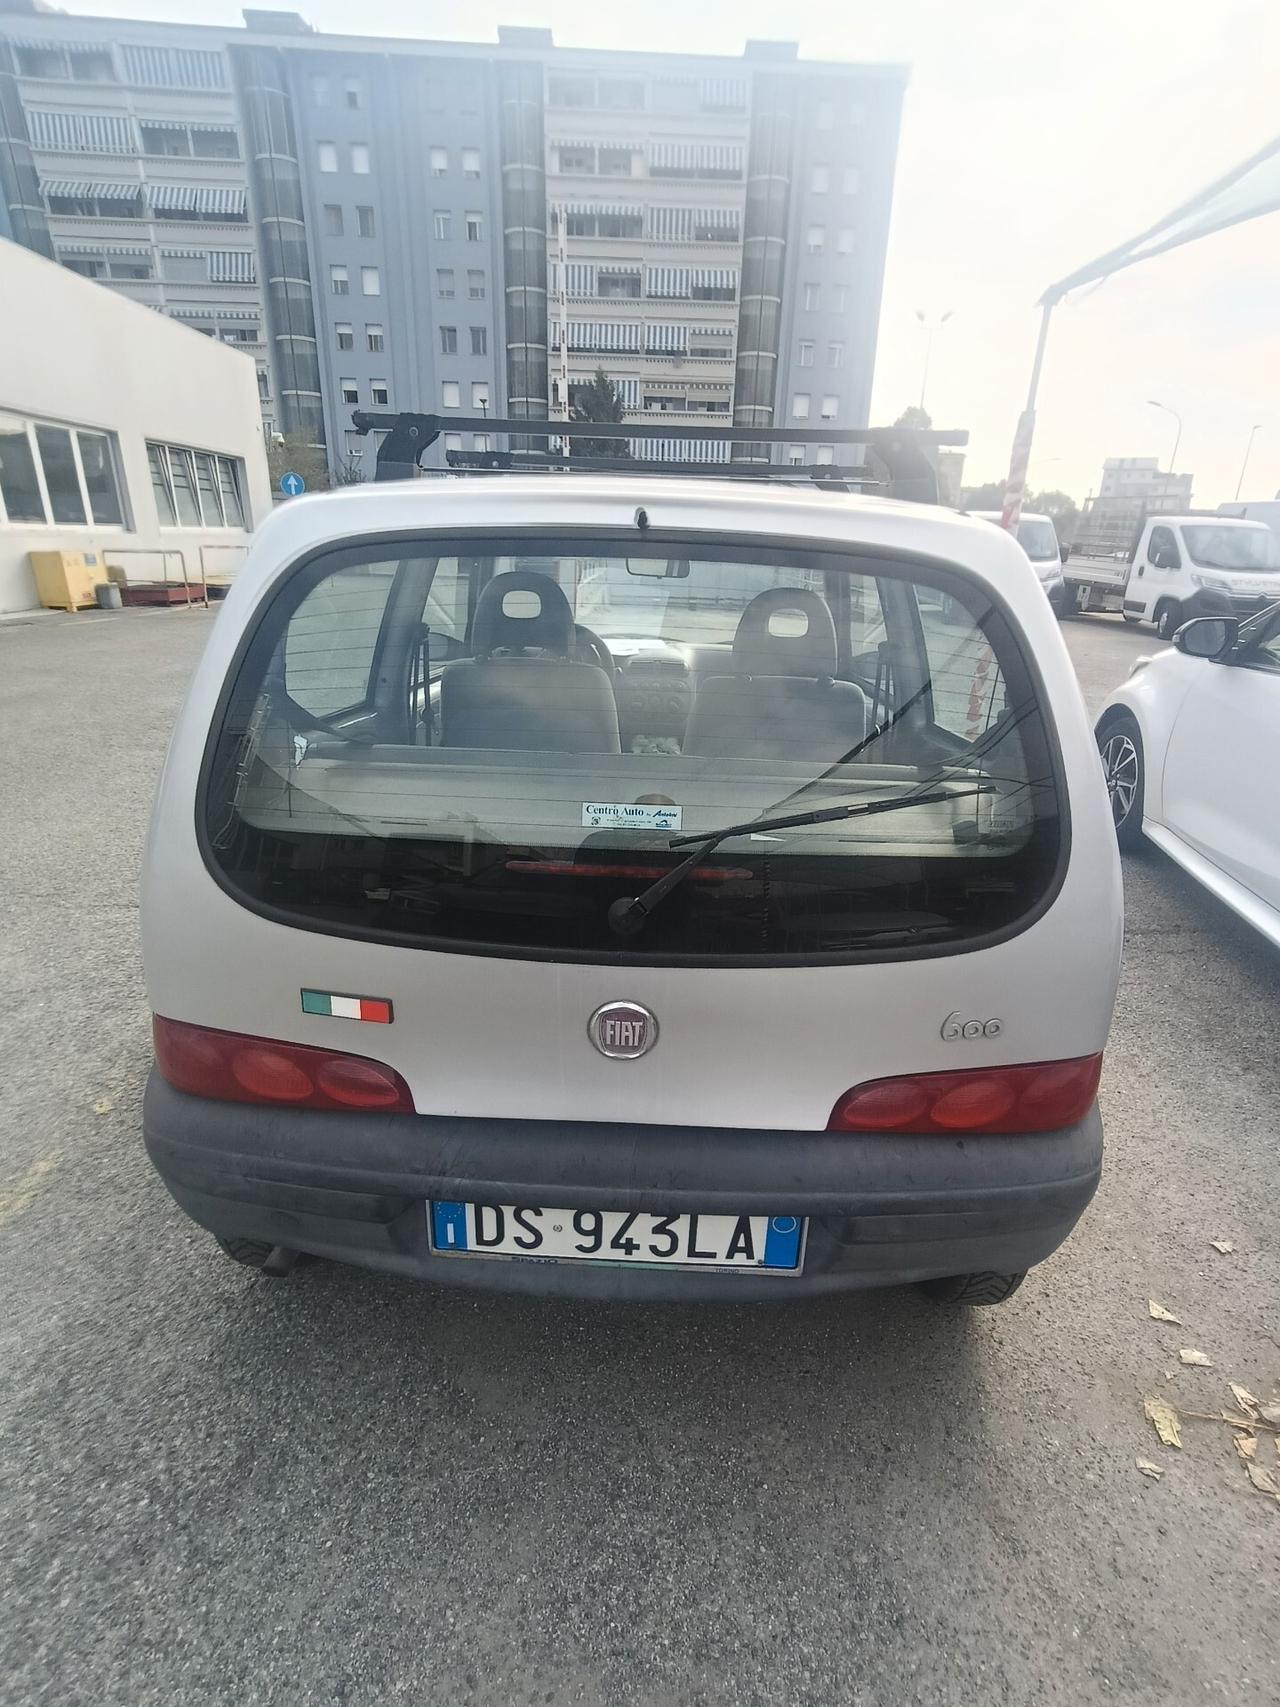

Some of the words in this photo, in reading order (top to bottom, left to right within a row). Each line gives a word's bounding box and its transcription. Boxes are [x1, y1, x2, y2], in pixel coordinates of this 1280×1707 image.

[586, 804, 619, 816] Centro
[621, 807, 644, 816] Auto
[606, 1020, 644, 1046] FIAT
[940, 1010, 1004, 1042] 600
[475, 1203, 544, 1250] DS
